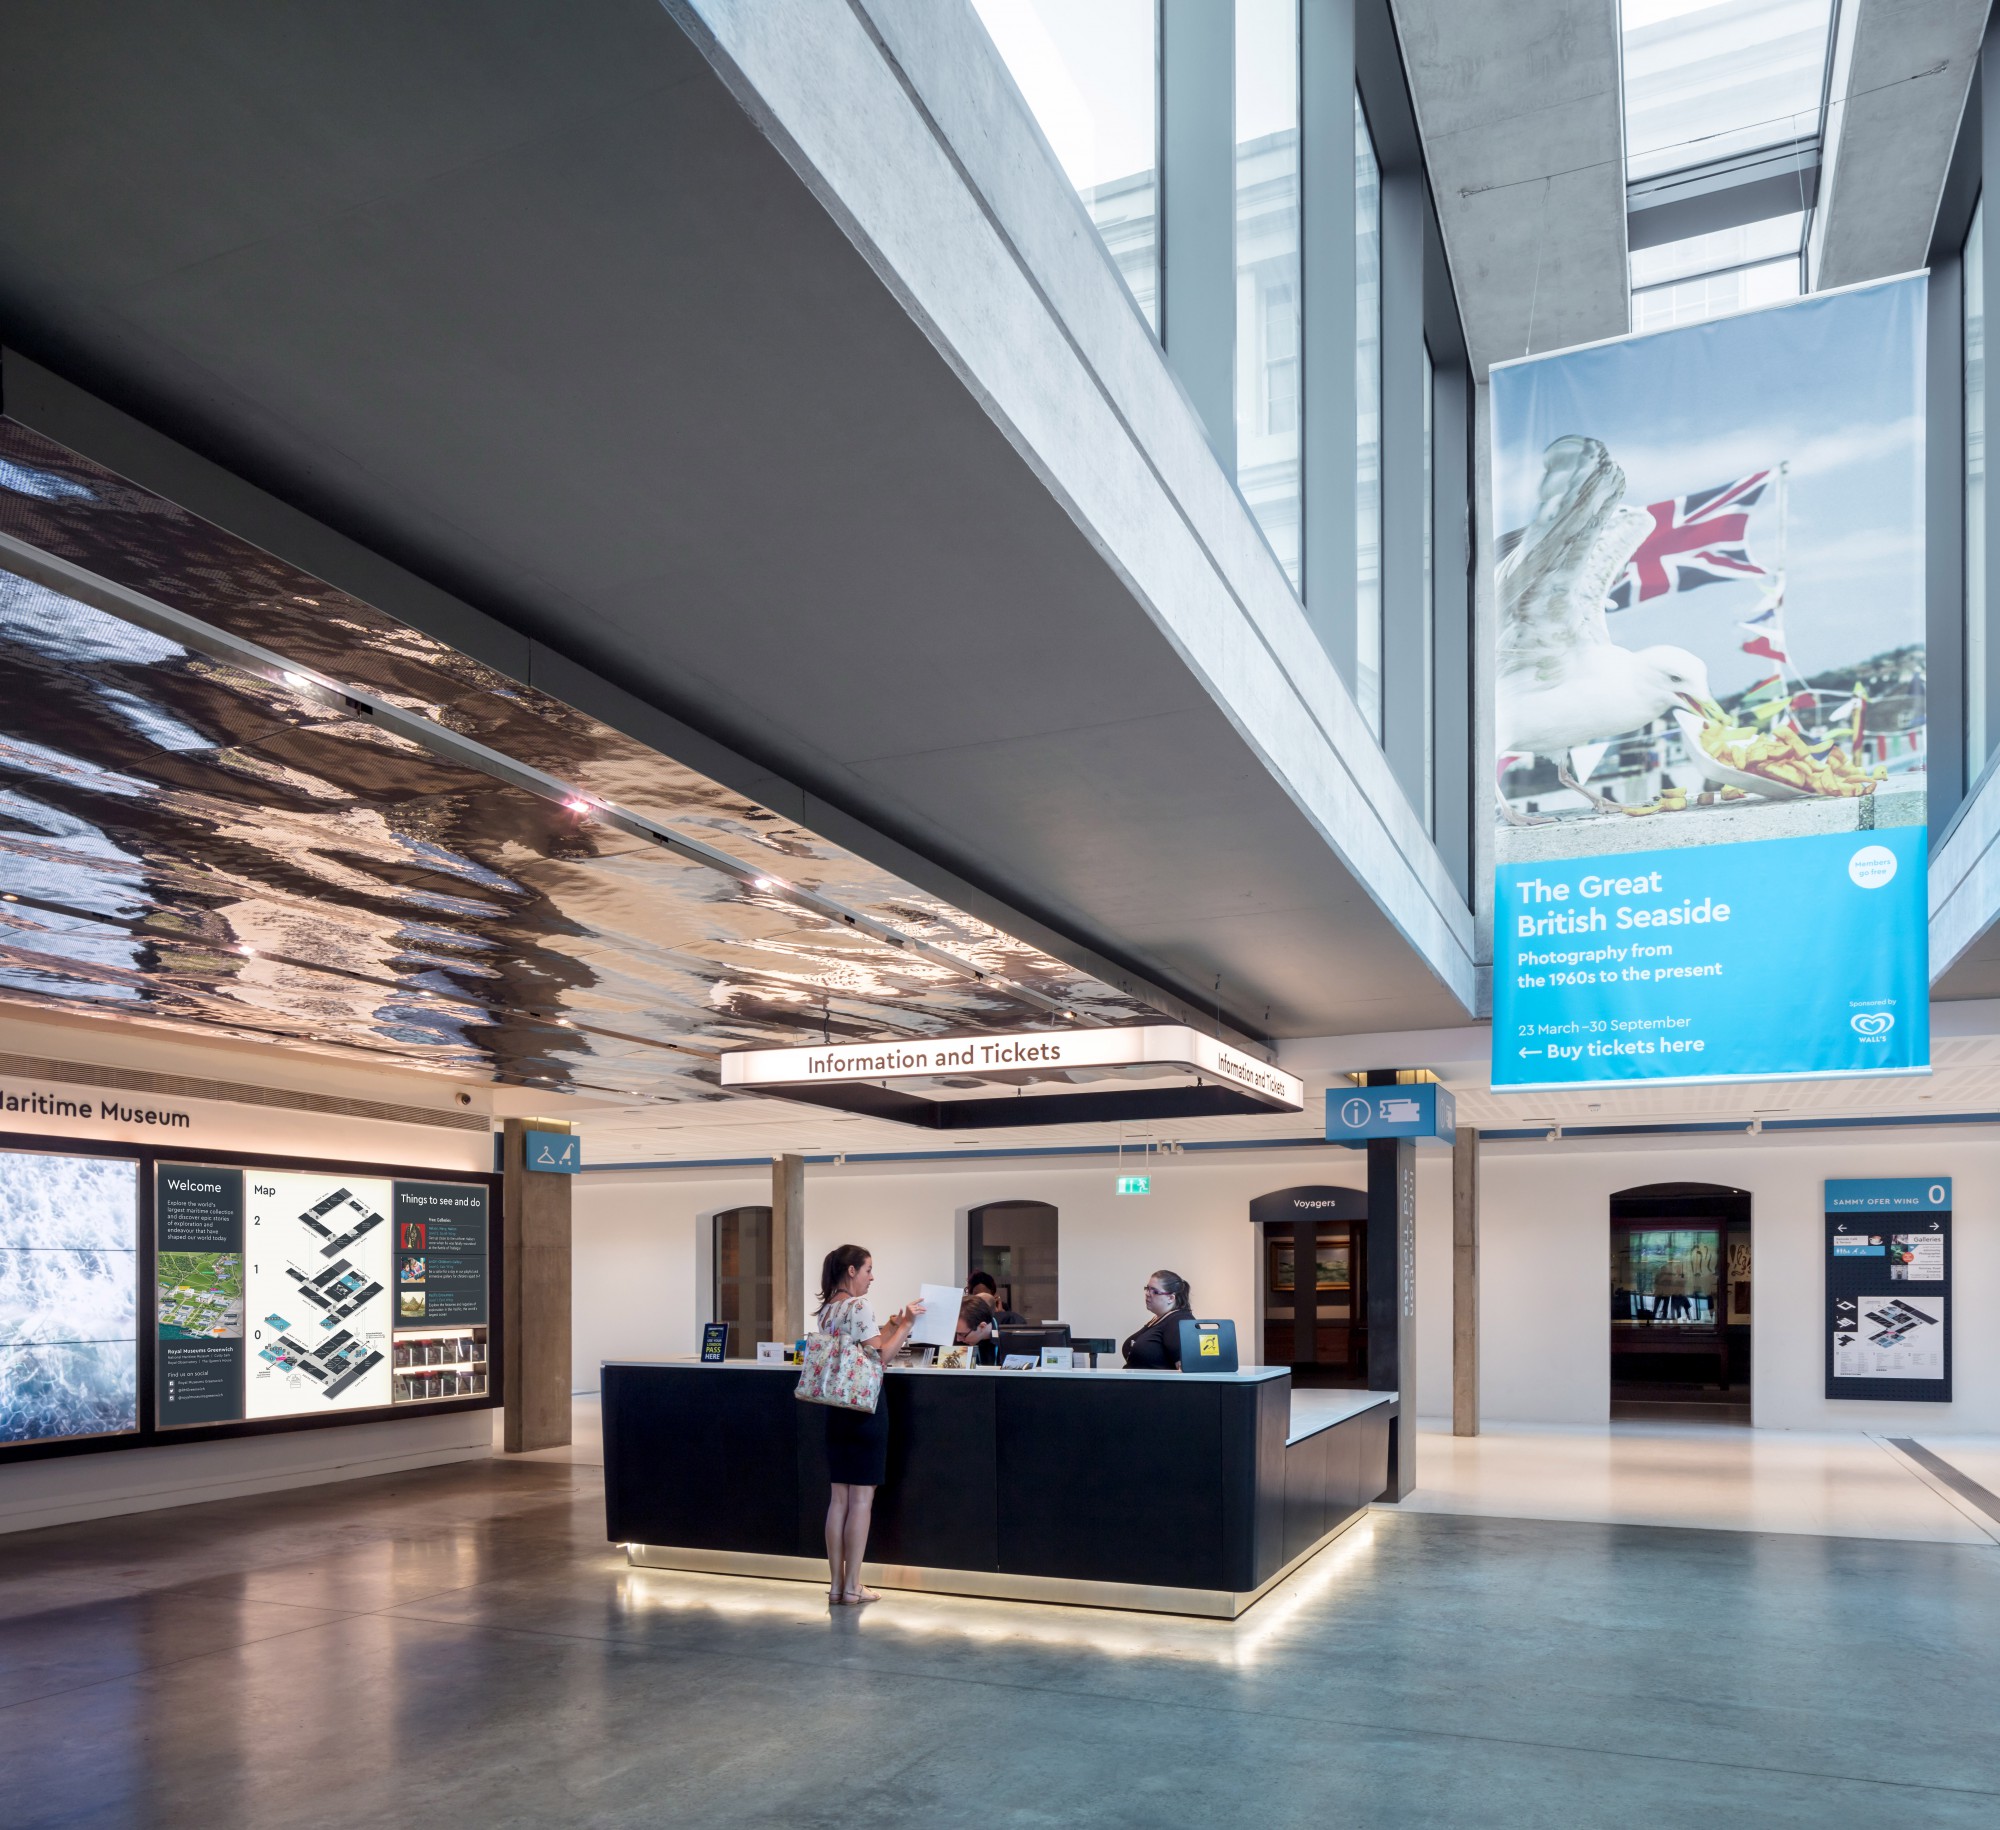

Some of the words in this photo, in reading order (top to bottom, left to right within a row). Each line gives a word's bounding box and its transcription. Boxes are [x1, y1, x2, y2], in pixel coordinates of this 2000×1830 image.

[1517, 879, 1569, 903] The
[1579, 871, 1662, 899] Great
[1518, 906, 1606, 937] British
[1616, 899, 1730, 930] Seaside
[1518, 942, 1627, 967] Photography
[1632, 943, 1672, 958] from
[1518, 974, 1545, 988] the
[1549, 971, 1596, 986] 1960s
[1600, 969, 1617, 983] to
[1622, 966, 1650, 981] the
[1655, 962, 1722, 981] present
[1519, 1025, 1534, 1036] 23
[1538, 1022, 1579, 1035] March
[1611, 1016, 1691, 1032] September
[808, 1049, 927, 1073] Information
[936, 1045, 973, 1066] and
[981, 1042, 1060, 1063] Tickets
[1547, 1044, 1583, 1059] Buy
[1587, 1039, 1655, 1056] tickets
[1660, 1038, 1704, 1053] here
[1219, 1053, 1253, 1083] Information
[1255, 1071, 1265, 1088] and
[1266, 1074, 1285, 1096] Tickets
[102, 1101, 190, 1128] Museum
[168, 1179, 221, 1192] Welcome
[255, 1185, 276, 1197] Map
[401, 1194, 427, 1205] Things
[429, 1196, 437, 1204] to
[455, 1197, 468, 1206] and
[471, 1198, 480, 1207] do
[1294, 1200, 1335, 1209] Voyagers
[255, 1216, 260, 1225] 2
[255, 1265, 259, 1274] 1
[255, 1330, 261, 1340] 0
